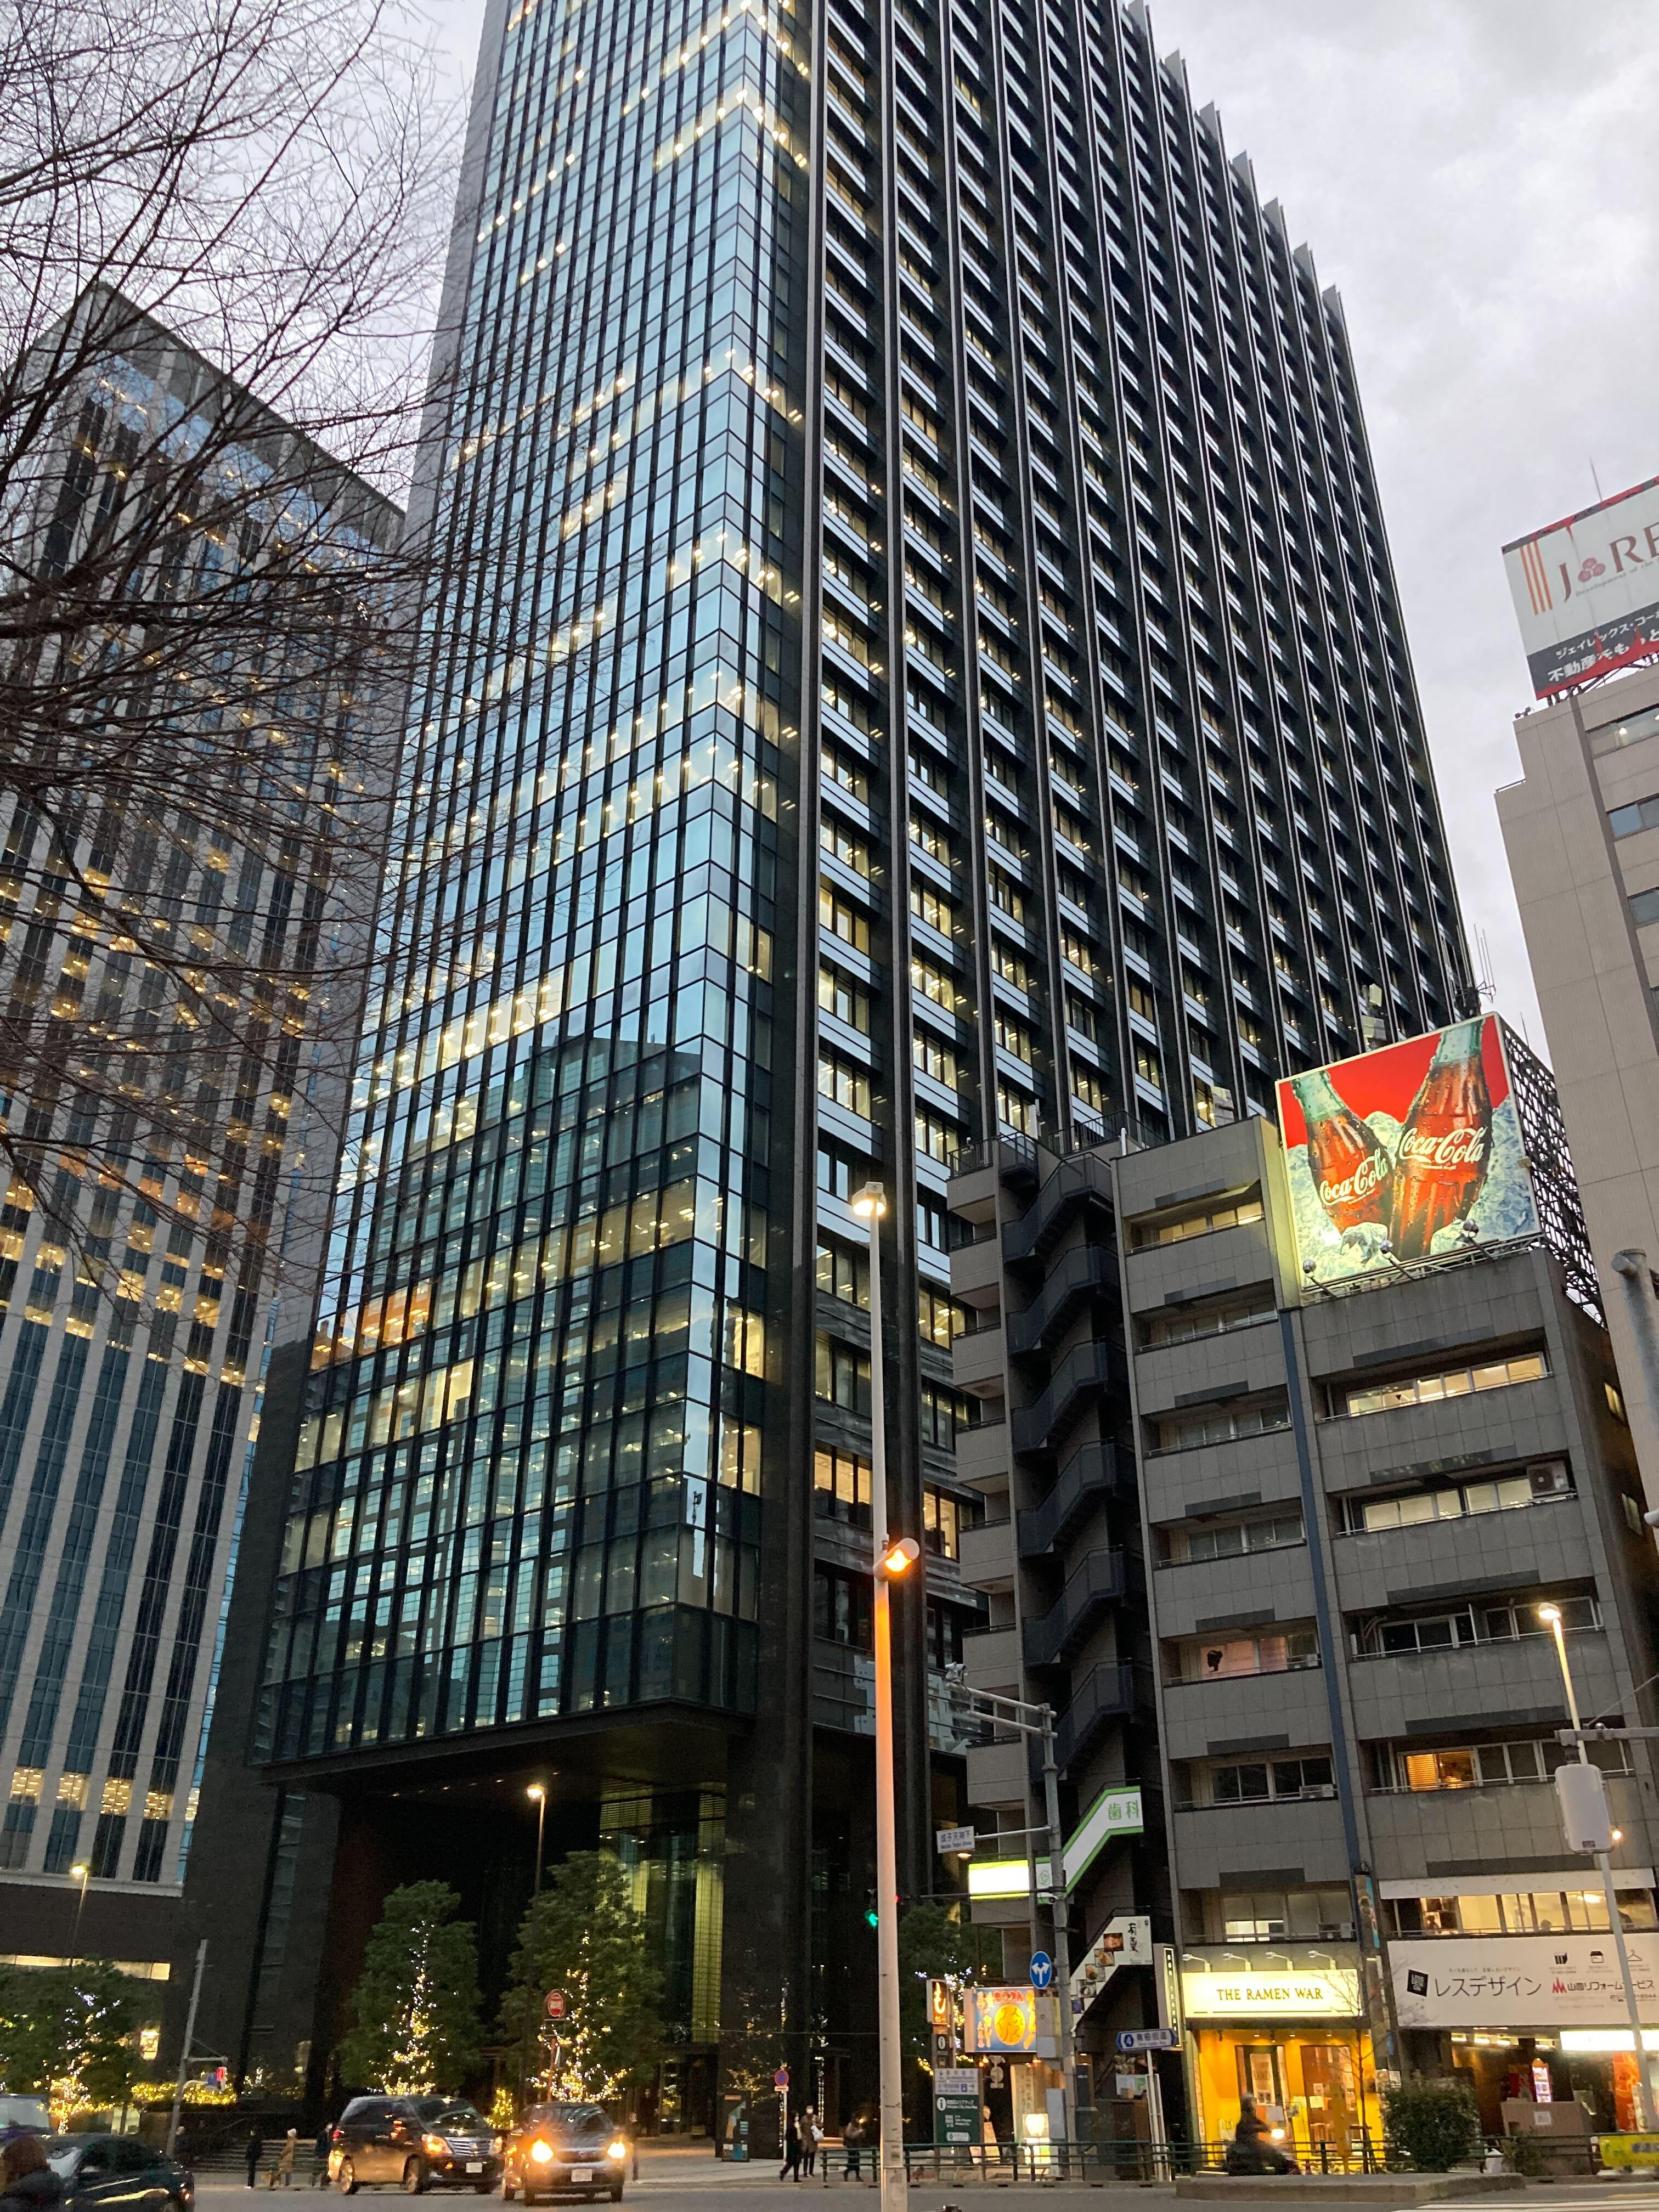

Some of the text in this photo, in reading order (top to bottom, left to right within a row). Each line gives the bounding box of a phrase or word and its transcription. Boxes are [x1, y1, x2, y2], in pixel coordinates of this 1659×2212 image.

[1399, 1126, 1488, 1164] Coca-Cola
[1320, 1147, 1389, 1206] Coca-Cola
[1108, 1800, 1140, 1820] 歯科
[1216, 1988, 1323, 2001] THE RAMEN WAR
[1435, 1975, 1542, 1997] レスデザイン
